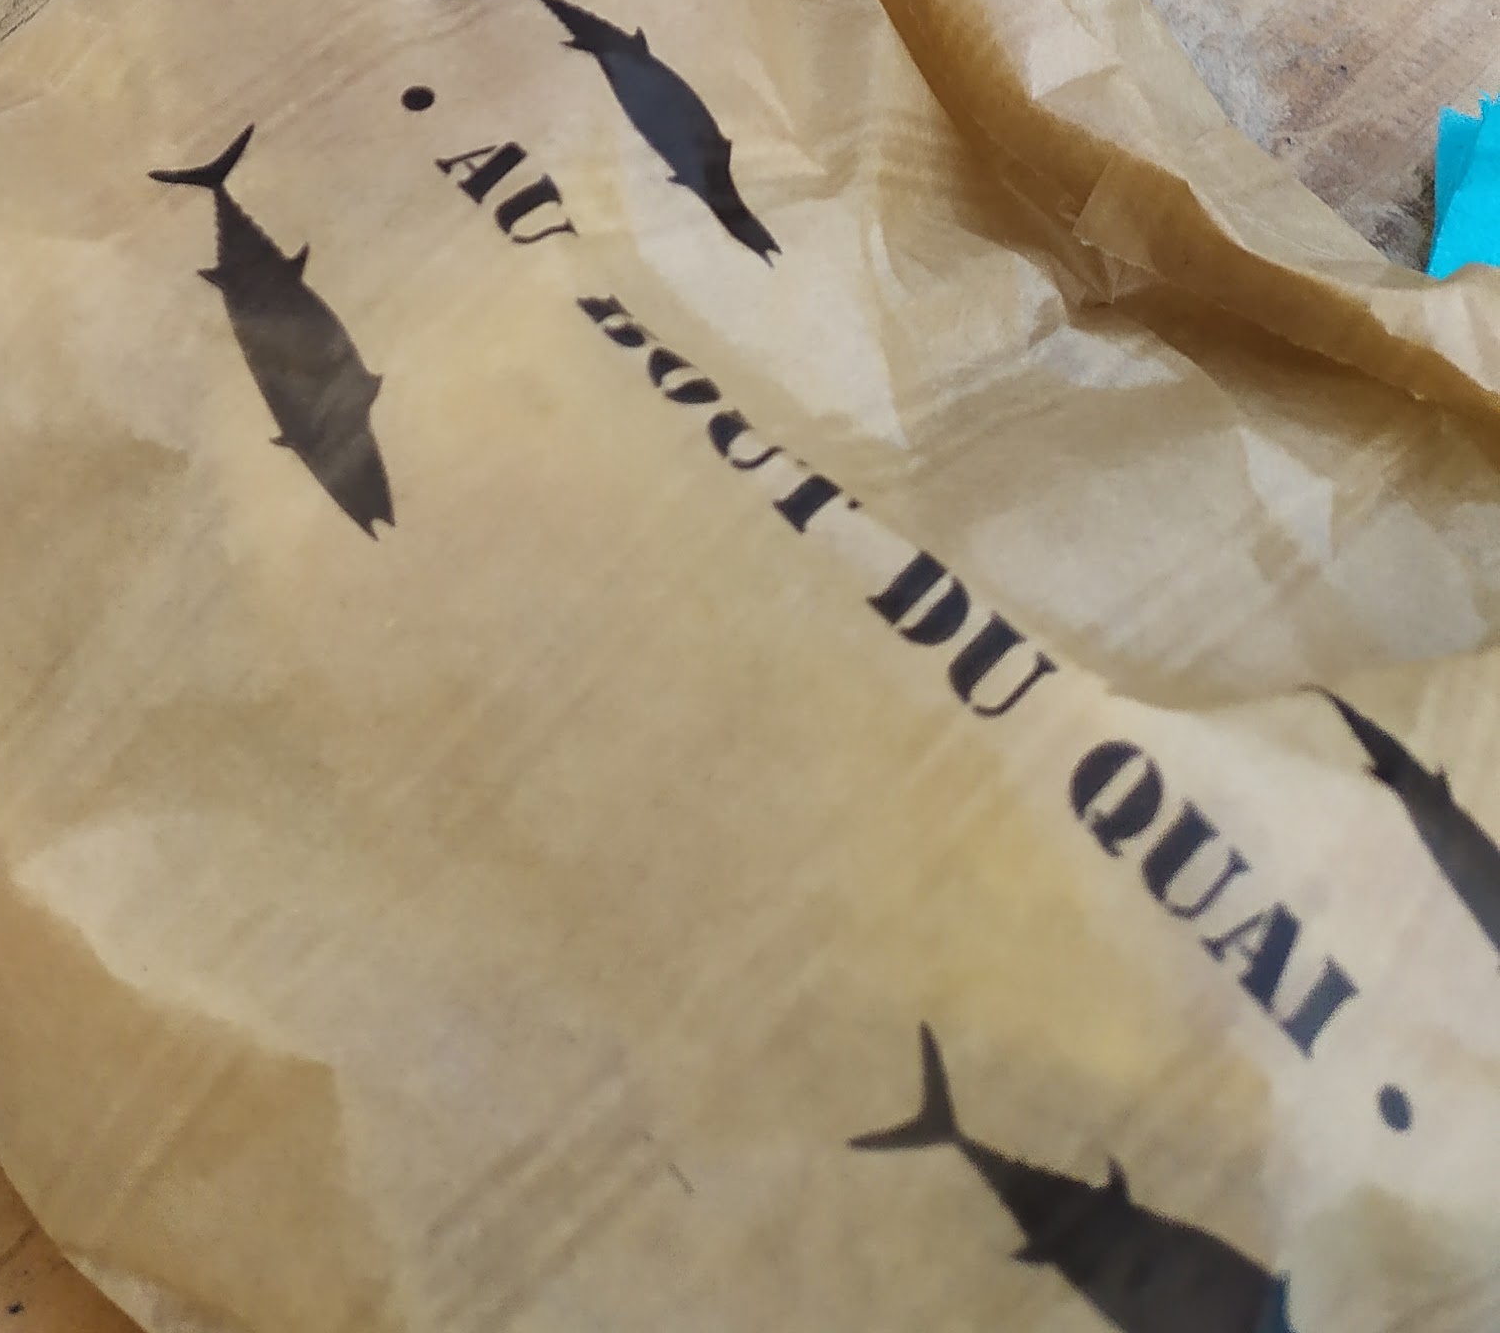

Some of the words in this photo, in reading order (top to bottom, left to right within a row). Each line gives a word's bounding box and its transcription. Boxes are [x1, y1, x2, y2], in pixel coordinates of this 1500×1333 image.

[434, 141, 580, 244] AU
[866, 550, 1058, 717] DU
[1068, 738, 1360, 1060] QUAI
